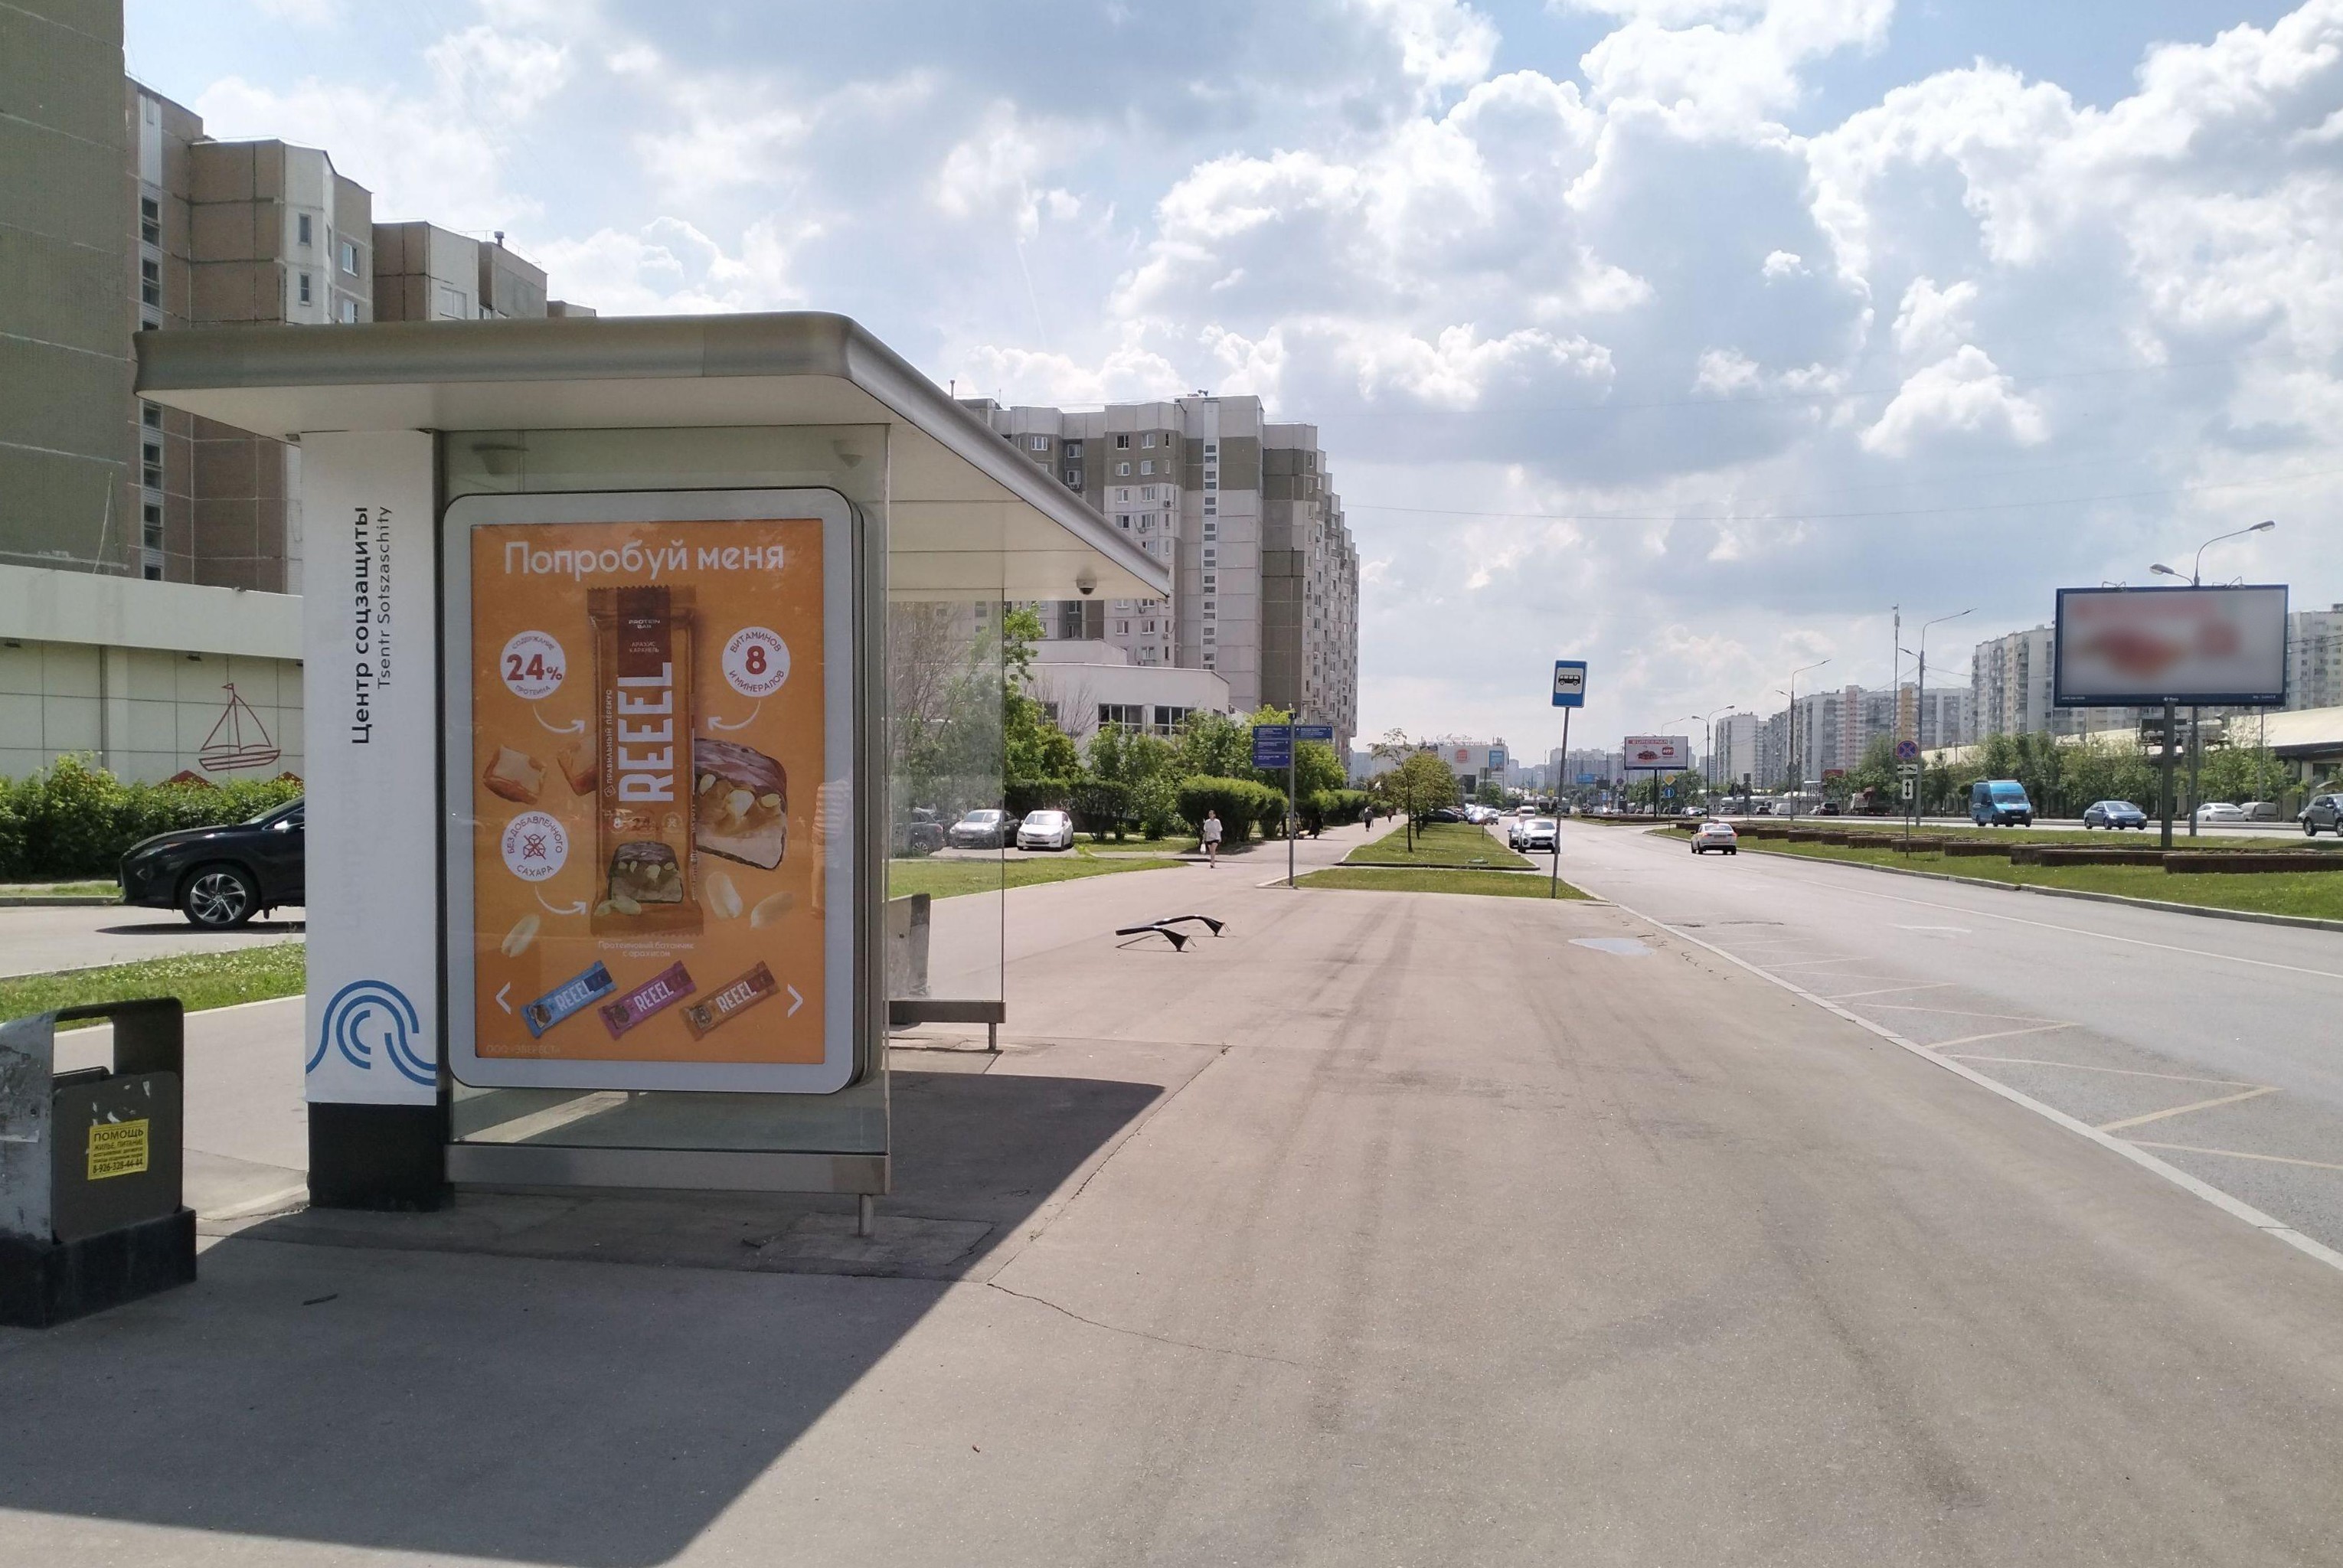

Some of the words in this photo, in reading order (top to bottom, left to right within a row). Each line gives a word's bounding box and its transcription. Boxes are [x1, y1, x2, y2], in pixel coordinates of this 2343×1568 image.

[376, 505, 394, 623] Sotszaschity
[505, 539, 688, 581] Попробуй
[698, 543, 784, 570] меня
[354, 507, 371, 655] соцзащиты
[377, 629, 390, 689] Tsentr
[730, 632, 782, 653] ВИТАМИНОВ
[506, 654, 563, 681] 24%
[745, 645, 767, 675] 8
[729, 670, 737, 678] И
[734, 670, 784, 692] МИНЕРАЛОВ
[352, 662, 372, 744] Центр
[605, 689, 613, 724] ПЕРЕКУС
[618, 662, 674, 802] REEEL
[605, 727, 613, 784] ПРАВИЛЬНЫЙ
[510, 815, 564, 854] ДОБАВЛЕННОГО
[517, 865, 554, 877] САХАРА
[554, 980, 594, 1011] REEEL
[633, 980, 674, 1013] REEEL
[714, 981, 756, 1013] REEEL
[93, 1129, 144, 1142] ПОМОЩЬ
